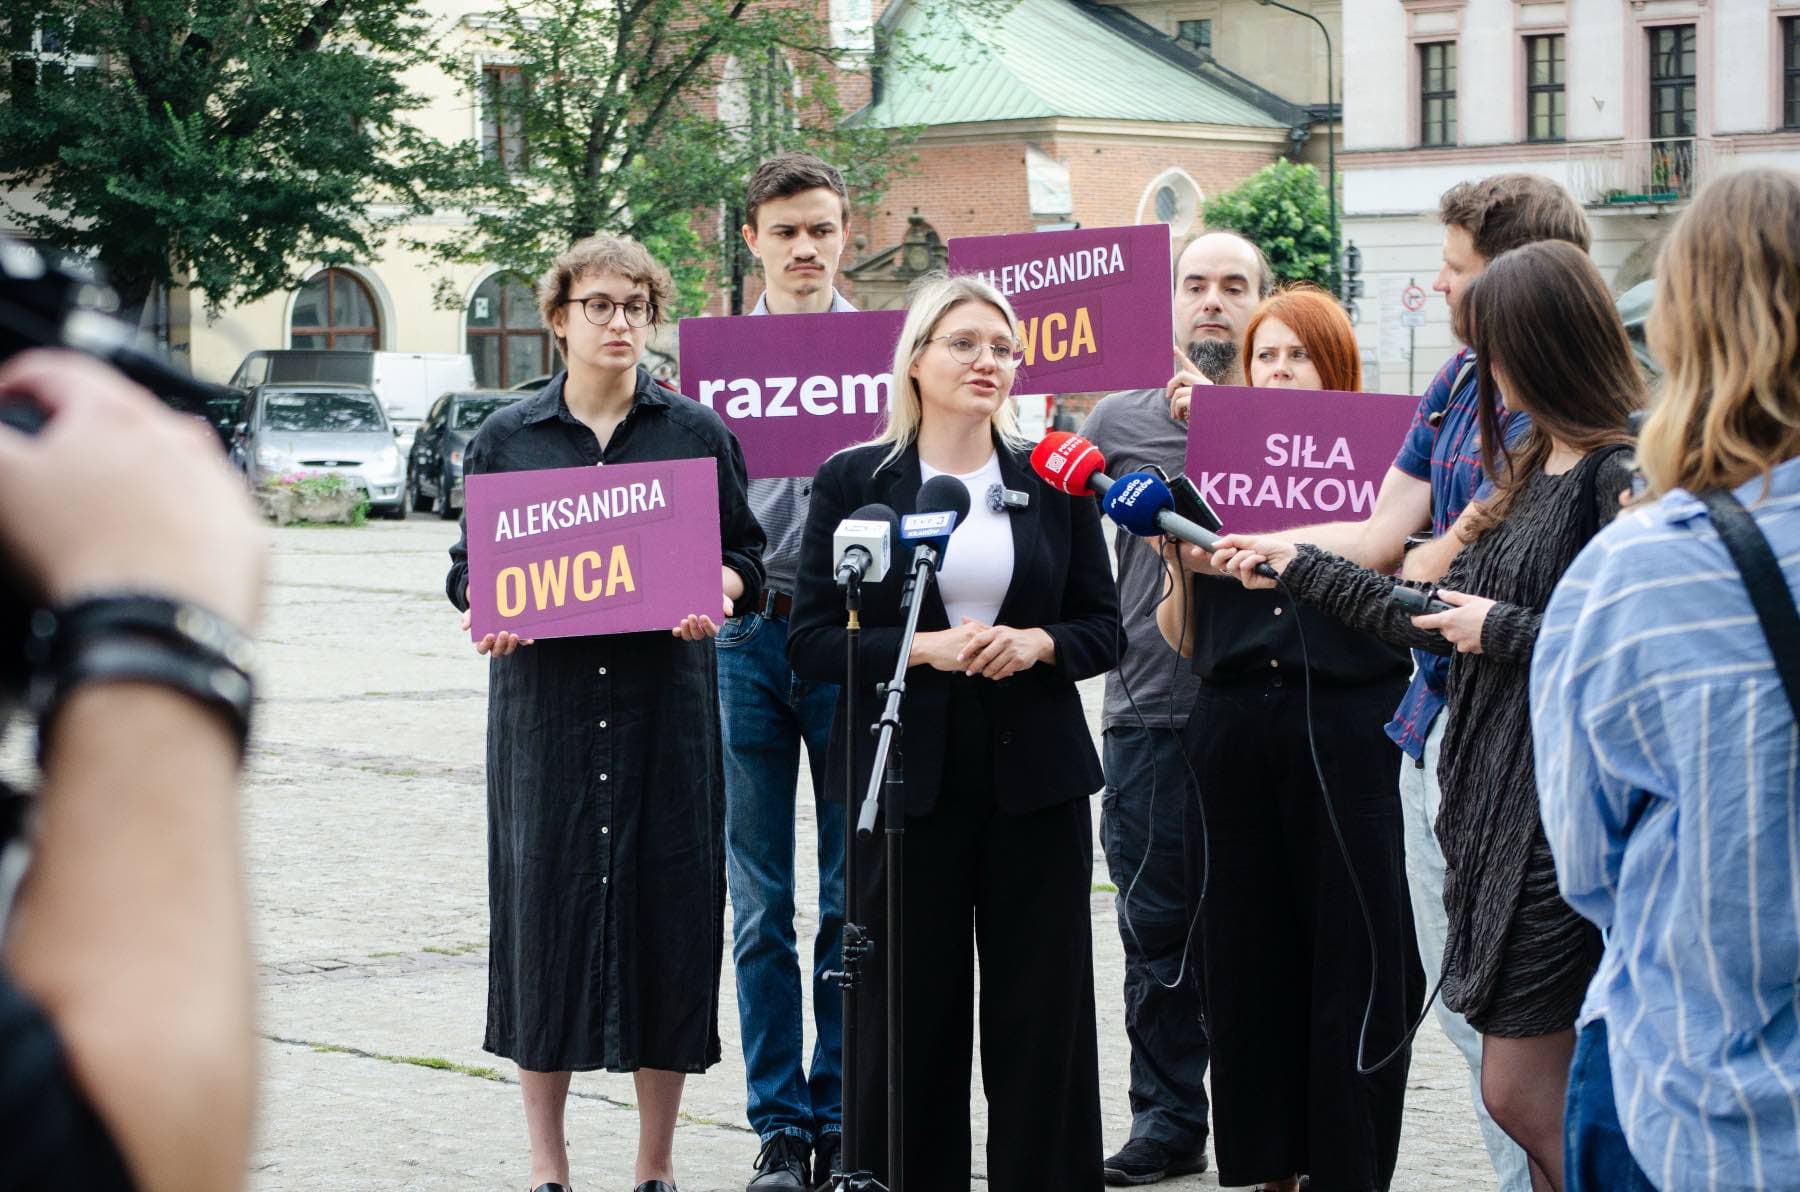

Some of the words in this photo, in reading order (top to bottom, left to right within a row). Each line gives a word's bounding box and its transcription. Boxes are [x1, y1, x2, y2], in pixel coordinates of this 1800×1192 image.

[698, 372, 894, 418] razem
[1264, 433, 1355, 470] SIŁA
[495, 479, 666, 542] ALEKSANDRA
[1118, 479, 1141, 504] Radio
[1125, 478, 1154, 507] Kraków
[496, 544, 636, 618] OWCA
